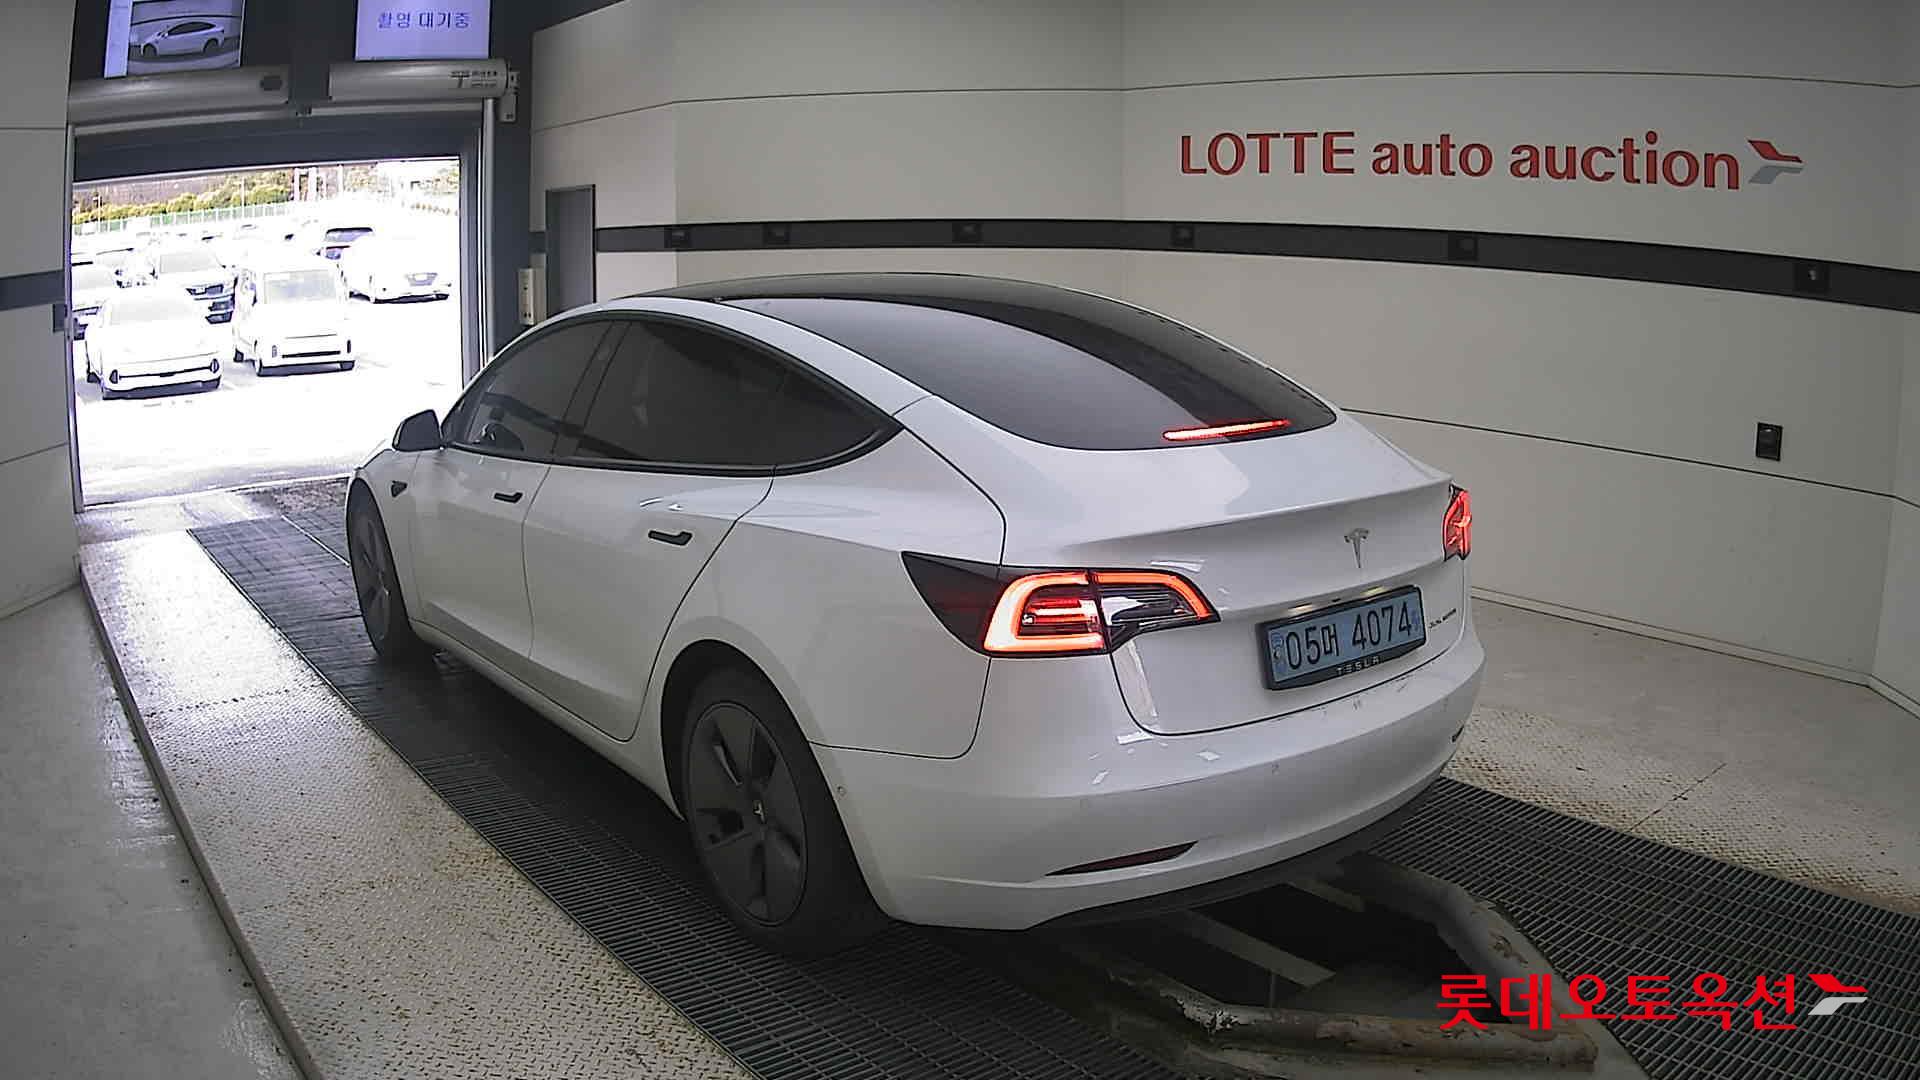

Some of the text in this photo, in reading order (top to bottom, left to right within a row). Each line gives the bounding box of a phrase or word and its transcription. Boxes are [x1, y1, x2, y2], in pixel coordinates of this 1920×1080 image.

[419, 12, 468, 28] 대기중
[1180, 130, 1740, 190] LOTTE auto auction
[1351, 601, 1412, 650] 4074
[1336, 655, 1381, 674] TESLA
